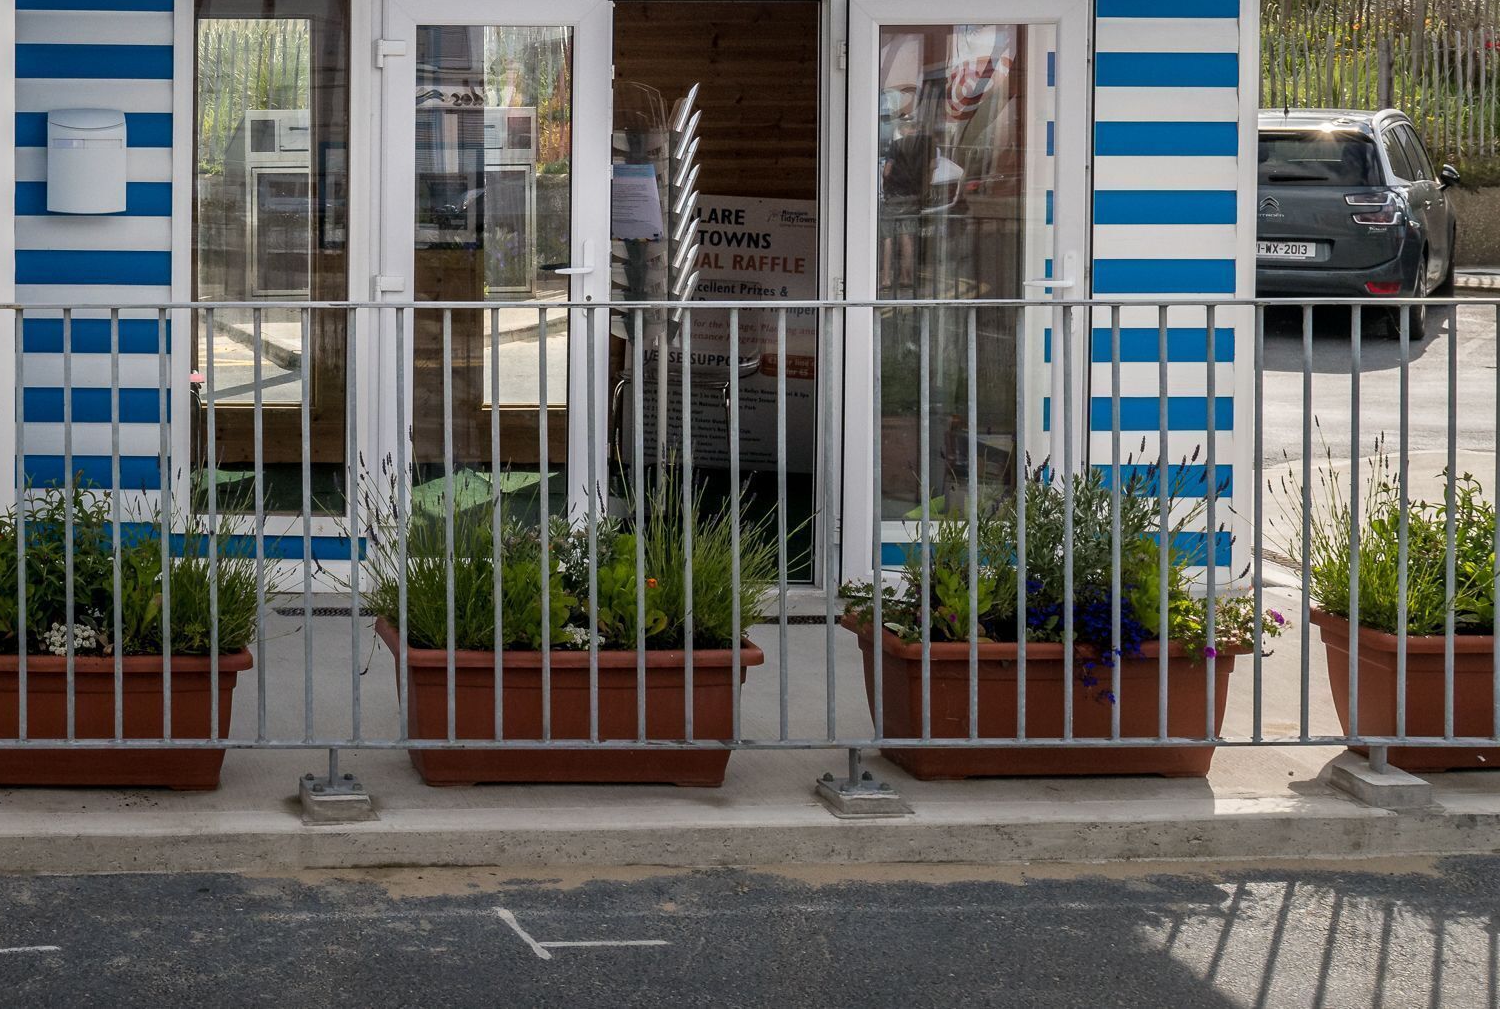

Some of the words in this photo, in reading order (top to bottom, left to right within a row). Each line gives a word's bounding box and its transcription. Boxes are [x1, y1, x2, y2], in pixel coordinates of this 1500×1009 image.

[690, 207, 746, 226] LARE
[1257, 243, 1308, 255] 1-WX-2013
[732, 254, 806, 275] RAFFLE
[695, 282, 736, 295] cellent
[740, 283, 776, 297] Prizes
[779, 286, 789, 298] &
[708, 320, 723, 329] the
